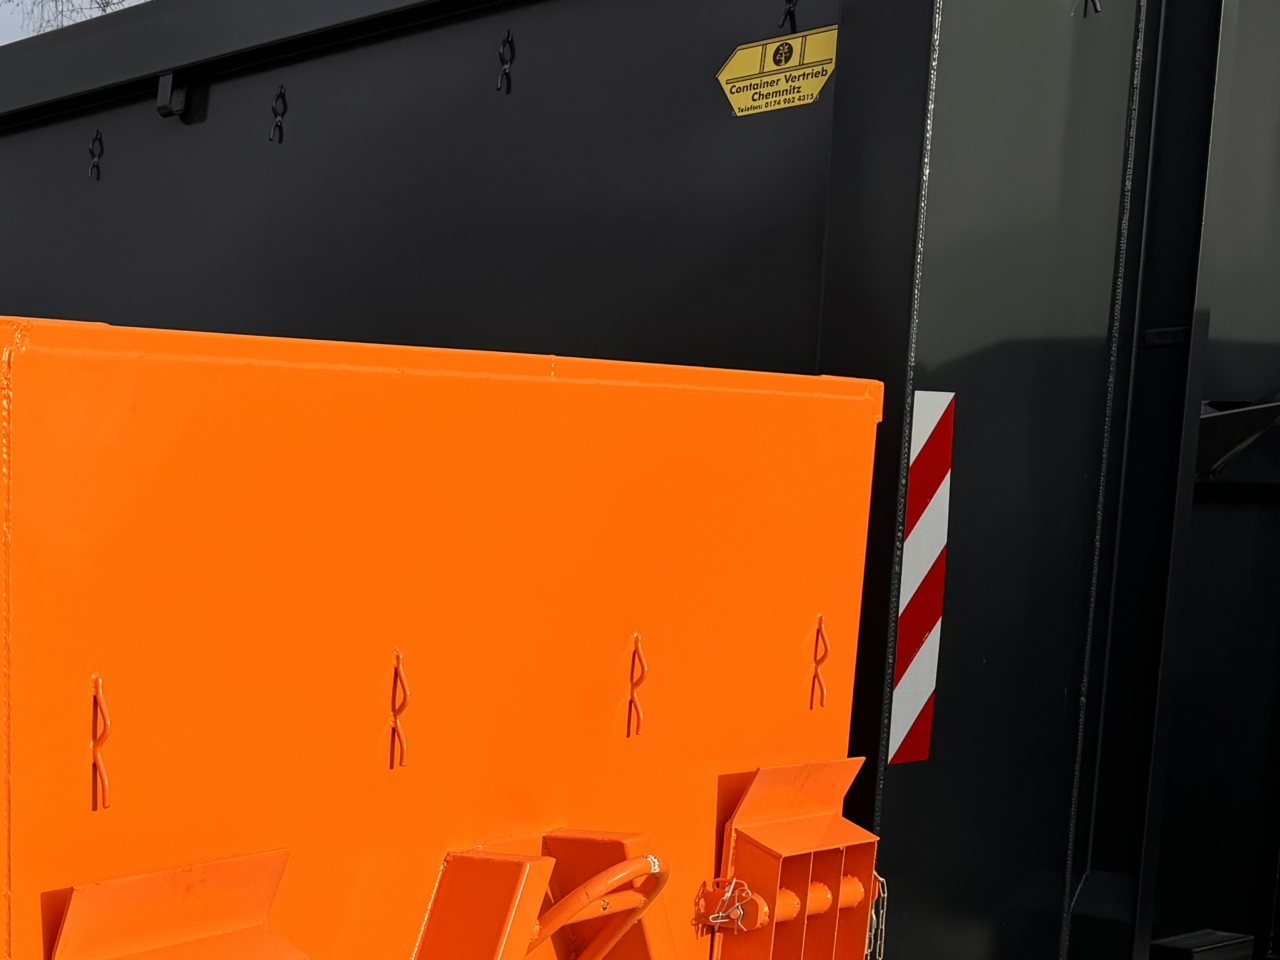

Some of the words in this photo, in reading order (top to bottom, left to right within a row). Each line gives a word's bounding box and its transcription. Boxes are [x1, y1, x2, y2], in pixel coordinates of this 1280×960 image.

[730, 78, 781, 95] Container
[784, 67, 828, 83] Vertrieb
[751, 85, 802, 102] Chemnitz
[737, 104, 763, 113] Telefon:
[765, 99, 781, 108] 0174
